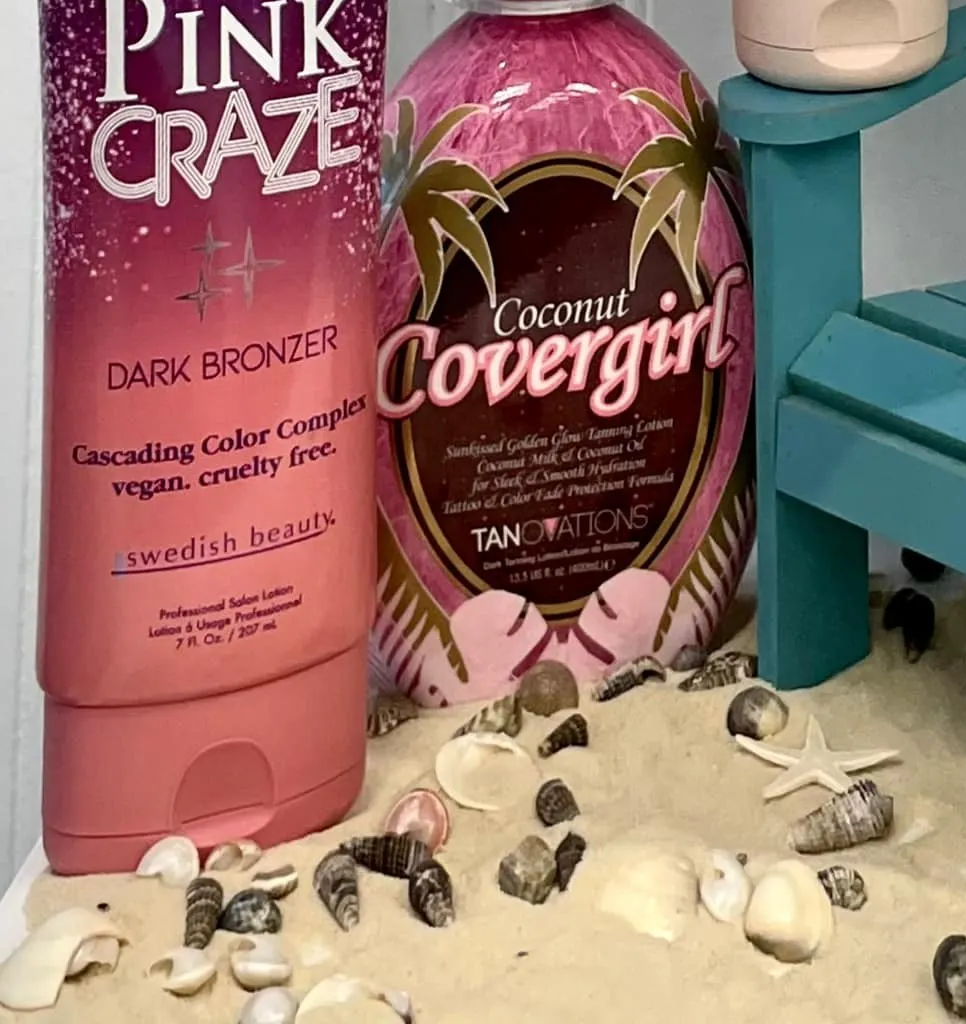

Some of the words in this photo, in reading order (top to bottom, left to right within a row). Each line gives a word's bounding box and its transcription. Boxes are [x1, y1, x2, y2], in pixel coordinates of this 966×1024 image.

[91, 70, 362, 207] CRAZE
[492, 287, 630, 336] Coconut
[108, 355, 192, 390] DARK
[202, 324, 338, 380] BRONZER
[376, 264, 746, 419] Covergirl
[72, 443, 195, 466] Cascading
[201, 428, 271, 455] Color
[276, 394, 368, 440] Complex
[506, 433, 549, 452] Golden
[551, 429, 582, 448] Glow
[588, 424, 634, 440] Tanning
[636, 417, 674, 433] Lotion
[112, 475, 191, 501] vegan.
[199, 455, 283, 488] cruelty
[288, 443, 338, 469] free.
[471, 477, 490, 497] for
[491, 473, 523, 490] Sleek
[541, 462, 586, 481] Smooth
[587, 456, 648, 478] Hydration
[477, 458, 525, 475] Coconut
[530, 451, 559, 466] Milk
[576, 444, 624, 461] Coconut
[627, 435, 648, 452] Oil
[443, 499, 482, 515] Tattoo
[500, 490, 532, 506] Color
[567, 479, 626, 497] Protection
[627, 468, 675, 490] Formula
[127, 532, 237, 568] swedish
[159, 600, 226, 621] Professional
[229, 593, 259, 608] Salon
[262, 585, 294, 602] Lotion
[149, 624, 181, 638] Lotion
[196, 616, 231, 632] Usage
[176, 639, 183, 650] 7
[238, 624, 260, 639] 207
